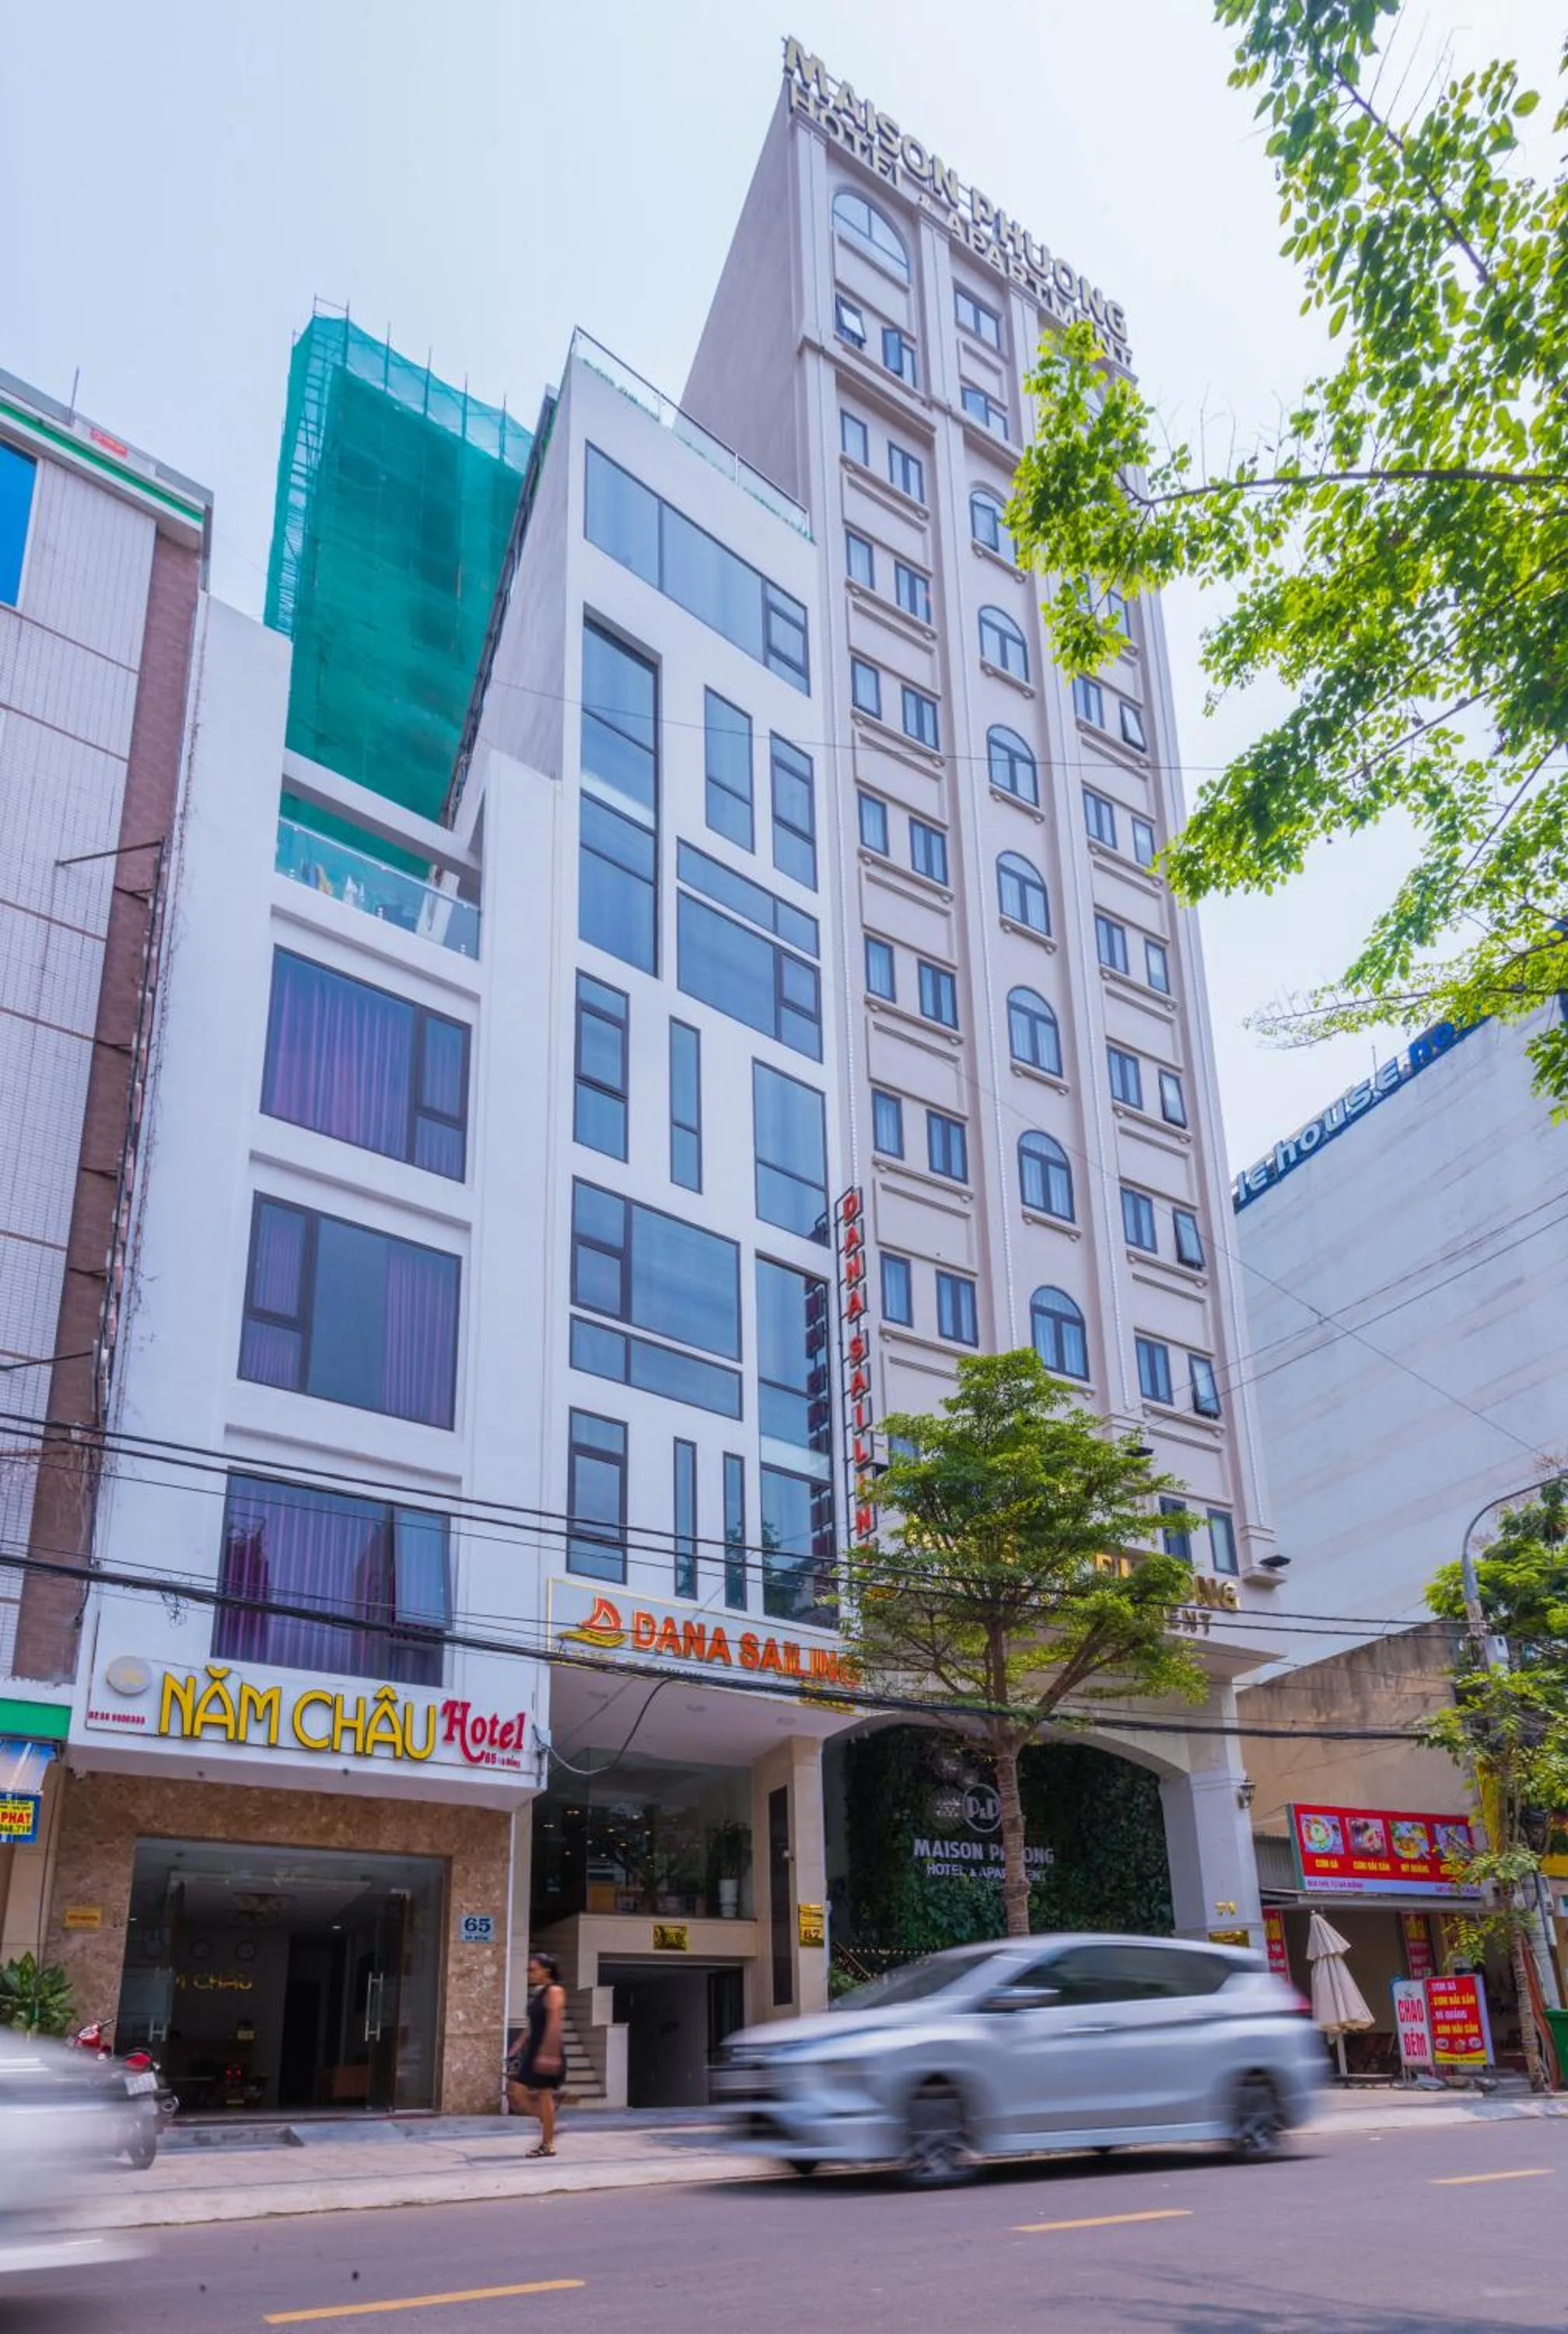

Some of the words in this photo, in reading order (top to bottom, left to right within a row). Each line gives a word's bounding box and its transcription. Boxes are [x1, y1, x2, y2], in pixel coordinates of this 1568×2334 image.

[782, 36, 960, 209] MAISON
[971, 186, 1128, 343] PHUONG
[789, 79, 902, 187] HOTEL
[946, 212, 1134, 370] APARTMNT
[843, 1193, 863, 1320] DANA
[632, 1609, 732, 1666] DANA
[158, 1664, 282, 1746] NĂM
[292, 1684, 436, 1761] CHÂU
[440, 1699, 526, 1764] Hotel
[914, 1838, 983, 1860] MAISON
[926, 1863, 965, 1877] HOTEL
[464, 1917, 491, 1933] 65
